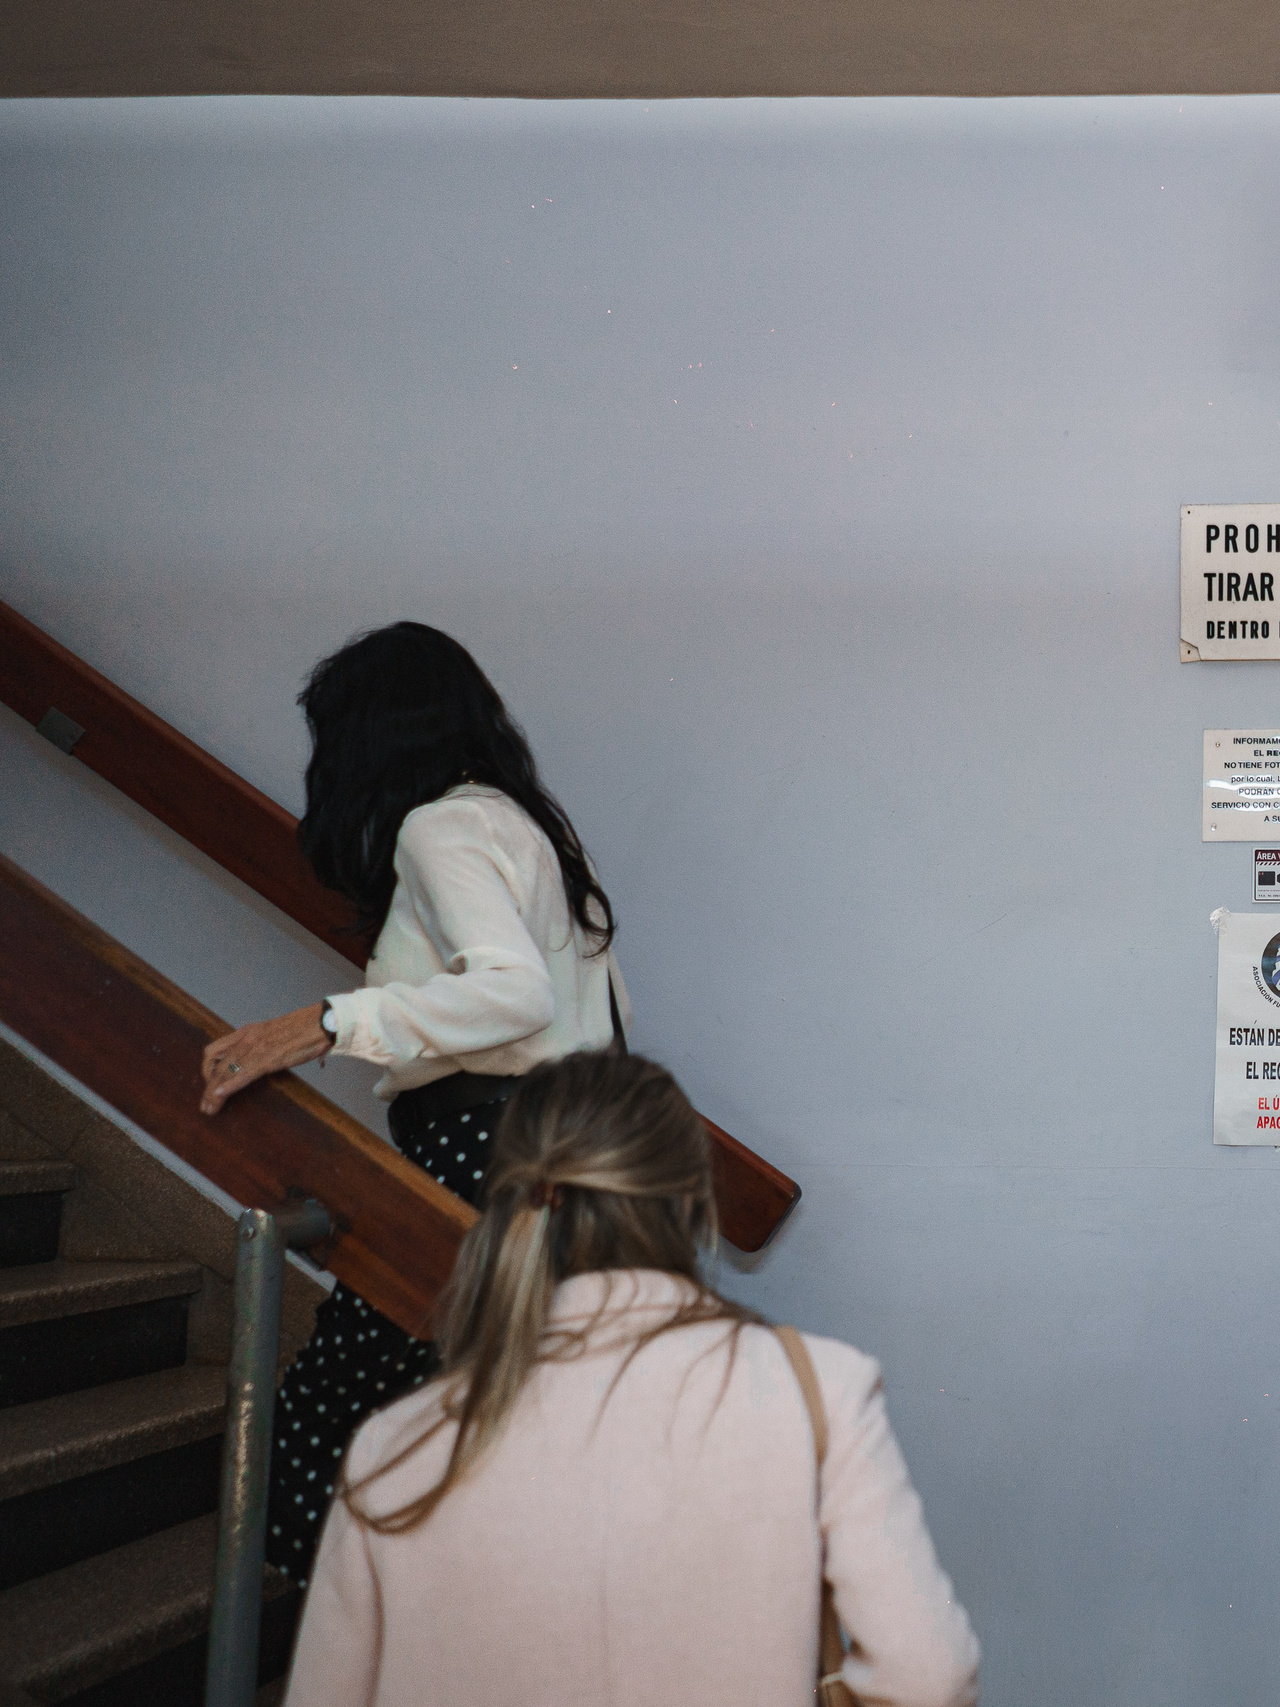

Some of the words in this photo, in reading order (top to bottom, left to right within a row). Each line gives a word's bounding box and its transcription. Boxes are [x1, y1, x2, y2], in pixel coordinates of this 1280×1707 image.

[1203, 572, 1274, 602] TIRAR
[1206, 620, 1270, 640] DENTRO
[1230, 776, 1245, 784] por
[1246, 775, 1254, 783] lo
[1238, 786, 1275, 796] PODRÁN
[1252, 801, 1271, 809] CON
[1257, 851, 1277, 860] ÁREA
[1252, 966, 1273, 1003] ASOCIACIÓN
[1229, 1020, 1265, 1046] ESTÁN
[1246, 1062, 1259, 1080] EL
[1258, 1097, 1270, 1110] EL
